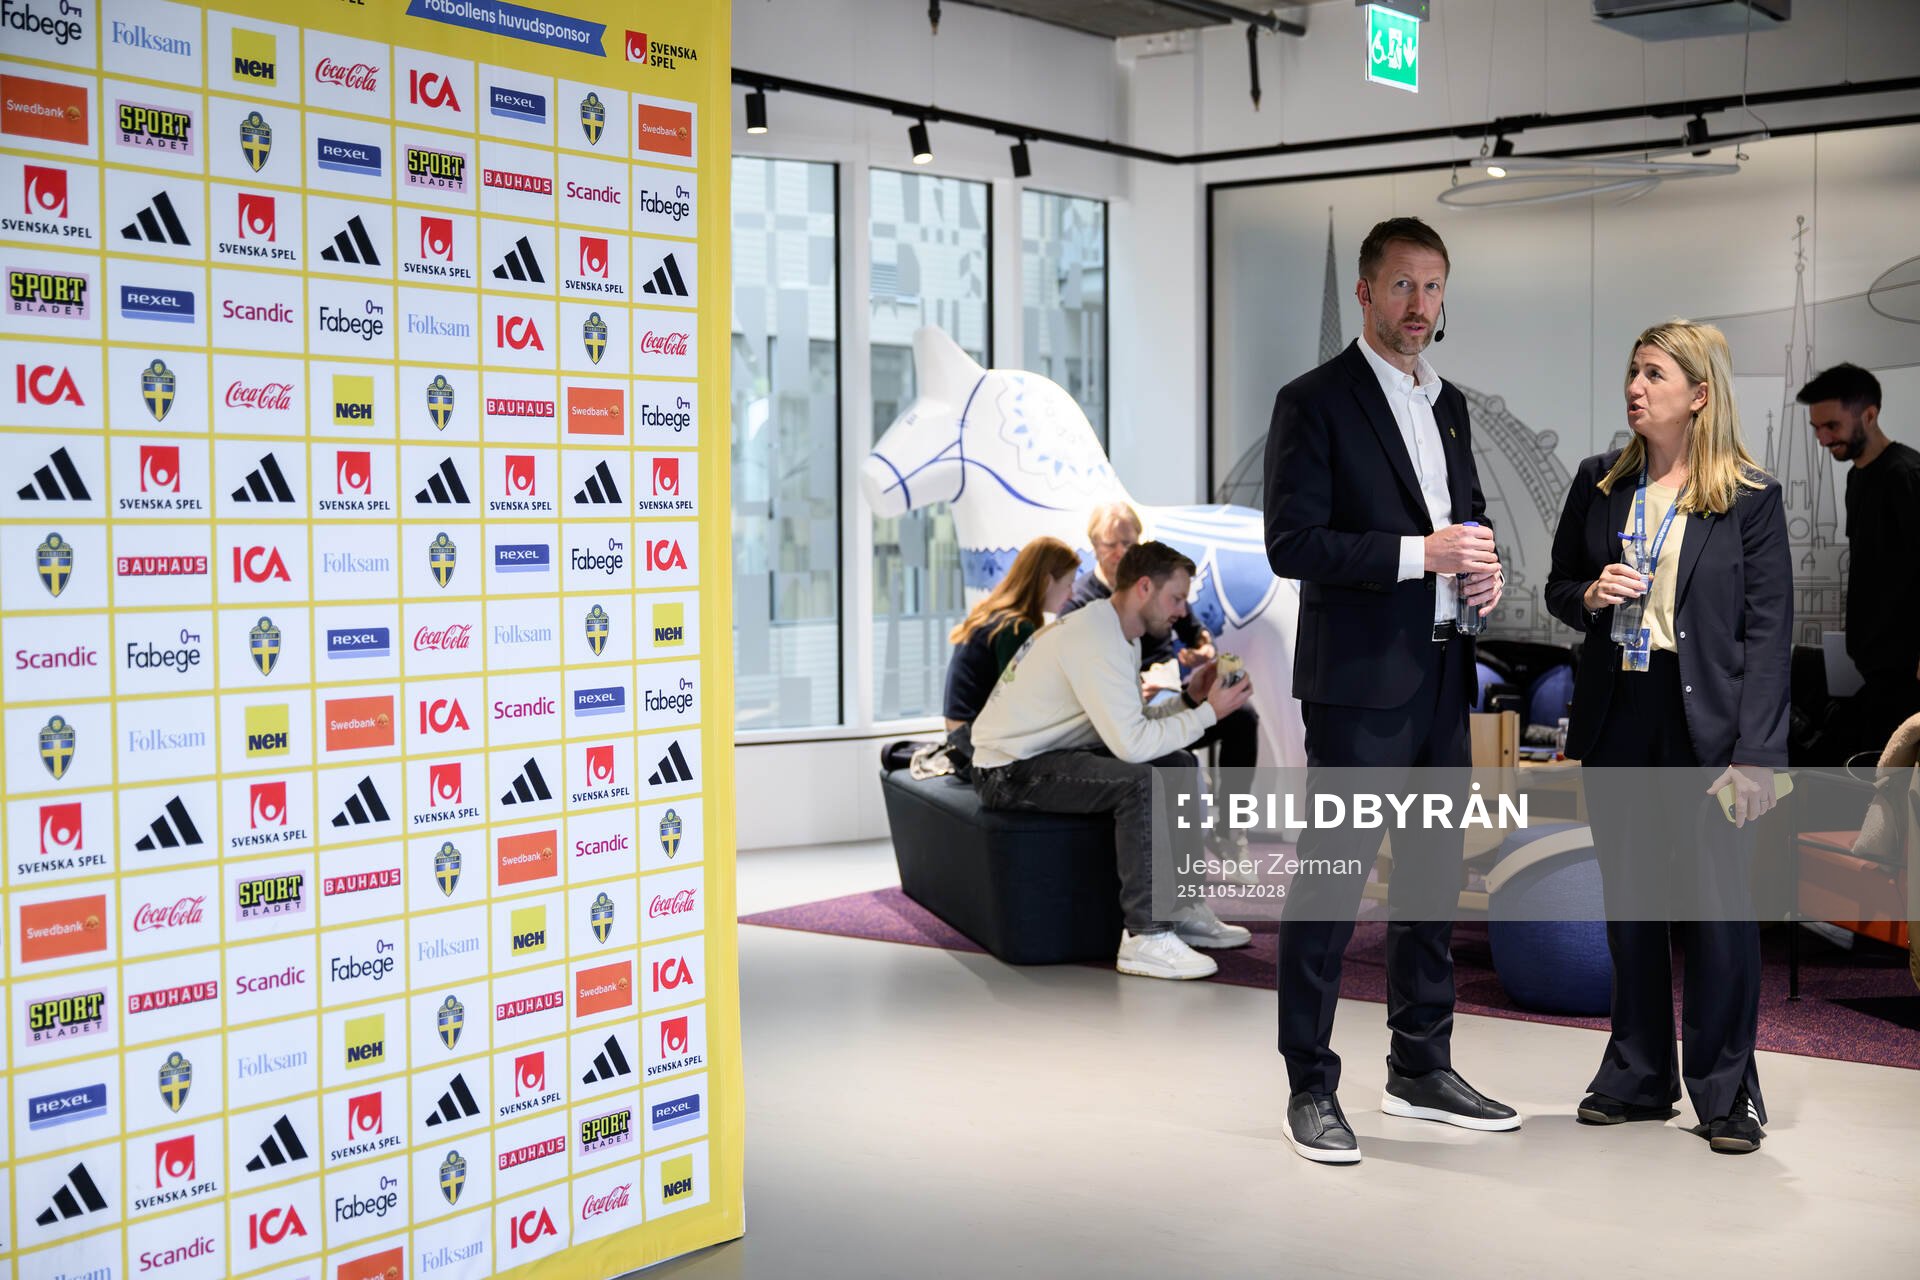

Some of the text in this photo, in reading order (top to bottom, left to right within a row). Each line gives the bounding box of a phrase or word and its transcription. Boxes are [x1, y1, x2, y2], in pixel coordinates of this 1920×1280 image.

[2, 0, 82, 45] Fabege
[498, 10, 590, 44] huvudsponsor
[112, 21, 191, 56] Folksam
[651, 42, 697, 61] SVENSKA
[651, 56, 676, 70] SPEL
[315, 58, 380, 92] Coca-Cola
[410, 69, 461, 112] ICA
[7, 100, 64, 119] Swedbank
[120, 105, 191, 144] SPORT
[643, 124, 678, 137] Swedbank
[123, 134, 189, 151] BLADET
[408, 149, 464, 181] SPORT
[411, 176, 463, 189] BLADET
[485, 171, 551, 193] BAUHAUS
[567, 182, 621, 204] Scandic
[640, 190, 690, 221] Fabege
[2, 219, 92, 238] SVENSKA SPEL
[219, 243, 296, 260] SVENSKA SPEL
[404, 263, 471, 279] SVENSKA SPEL
[10, 271, 85, 306] SPORT
[565, 280, 624, 294] SVENSKA SPEL
[15, 302, 84, 315] BLADET
[223, 300, 294, 323] Scandic
[320, 306, 383, 341] Fabege
[408, 314, 470, 337] Folksam
[497, 315, 544, 351] ICA
[641, 331, 689, 356] Coca-Cola
[16, 364, 85, 406] ICA
[225, 381, 295, 410] Coca-Cola
[488, 399, 553, 415] BAUHAUS
[572, 406, 608, 416] Swedbank
[642, 404, 690, 432] Fabege
[120, 498, 202, 510] SVENSKA SPEL
[319, 500, 390, 511] SVENSKA SPEL
[490, 501, 552, 511] SVENSKA SPEL
[639, 500, 693, 510] SVENSKA SPEL
[118, 557, 206, 574] BAUHAUS
[233, 546, 291, 583] ICA
[323, 552, 389, 573] Folksam
[572, 549, 623, 574] Fabege
[646, 539, 687, 571] ICA
[414, 624, 473, 651] Coca-Cola
[494, 625, 551, 644] Folksam
[16, 646, 97, 669] Scandic
[128, 642, 200, 672] Fabege
[494, 697, 555, 719] Scandic
[646, 689, 693, 714] Fabege
[331, 717, 375, 730] Swedbank
[420, 698, 470, 734] ICA
[129, 729, 205, 752] Folksam
[572, 787, 630, 802] SVENSKA SPEL
[414, 808, 480, 824] SVENSKA SPEL
[232, 830, 308, 847] SVENSKA SPEL
[576, 834, 628, 858] Scandic
[18, 854, 107, 875] SVENSKA SPEL
[502, 852, 541, 865] Swedbank
[239, 874, 302, 908] SPORT
[326, 870, 399, 895] BAUHAUS
[133, 896, 207, 932] Coca-Cola
[242, 902, 301, 917] BLADET
[649, 889, 697, 919] Coca-Cola
[27, 919, 83, 939] Swedbank
[418, 940, 479, 962] Folksam
[236, 967, 305, 994] Scandic
[331, 956, 394, 982] Fabege
[653, 956, 693, 992] ICA
[130, 982, 216, 1012] BAUHAUS
[580, 982, 617, 998] Swedbank
[29, 992, 104, 1032] SPORT
[498, 992, 562, 1020] BAUHAUS
[34, 1021, 103, 1041] BLADET
[238, 1051, 308, 1079] Folksam
[648, 1056, 702, 1076] SVENSKA SPEL
[500, 1092, 561, 1117] SVENSKA SPEL
[582, 1110, 631, 1144] SPORT
[331, 1136, 401, 1160] SVENSKA SPEL
[499, 1137, 564, 1169] BAUHAUS
[585, 1133, 630, 1152] BLADET
[135, 1182, 217, 1210] SVENSKA SPEL
[335, 1192, 398, 1222] Fabege
[582, 1183, 632, 1220] Coca-Cola
[249, 1204, 308, 1249] ICA
[510, 1207, 558, 1249] ICA
[140, 1237, 215, 1272] Scandic
[422, 1240, 483, 1273] Folksam
